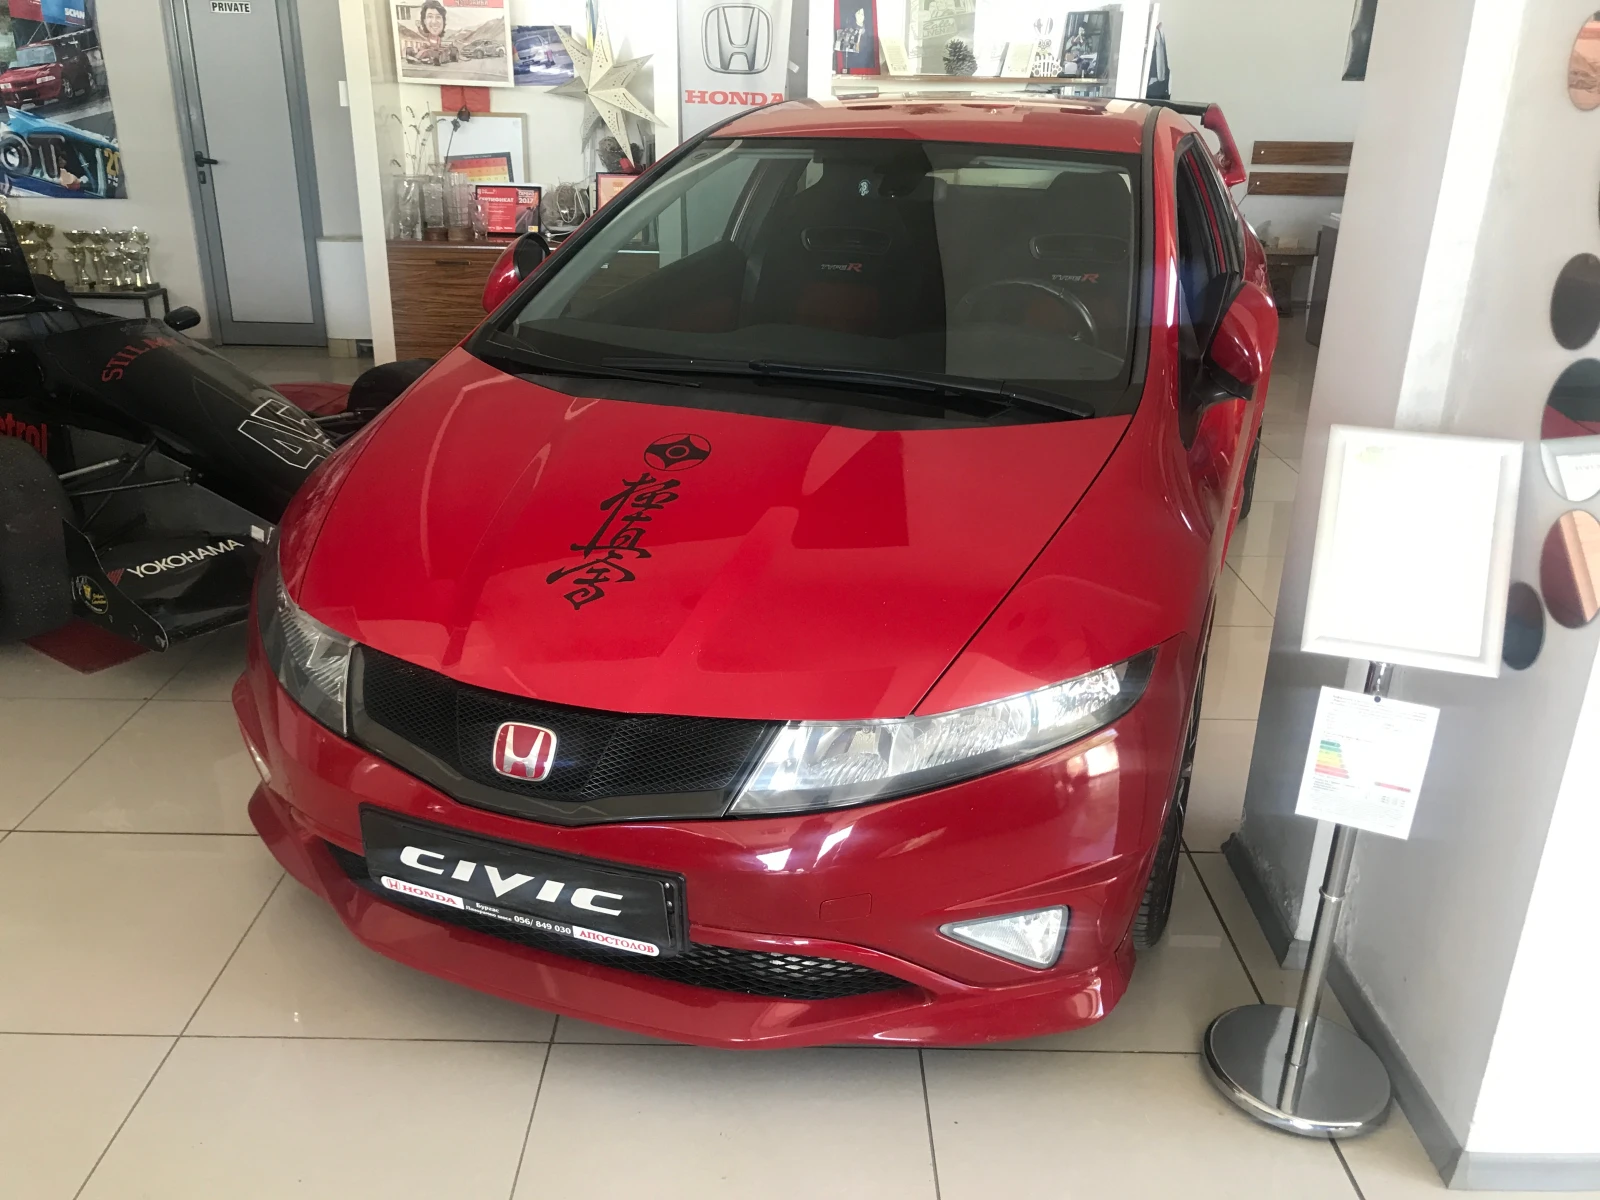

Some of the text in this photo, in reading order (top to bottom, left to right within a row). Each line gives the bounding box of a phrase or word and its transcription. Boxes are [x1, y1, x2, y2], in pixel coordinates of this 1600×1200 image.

[212, 2, 250, 13] PRIVATE
[685, 90, 784, 106] HONDA
[126, 539, 244, 579] YOKOHAMA
[399, 846, 624, 916] CIVIC
[402, 884, 457, 906] HONDA
[475, 902, 500, 914] Бургас
[513, 915, 571, 935] 056/ 849 030
[579, 930, 654, 953] АПОСТОЛОВ
